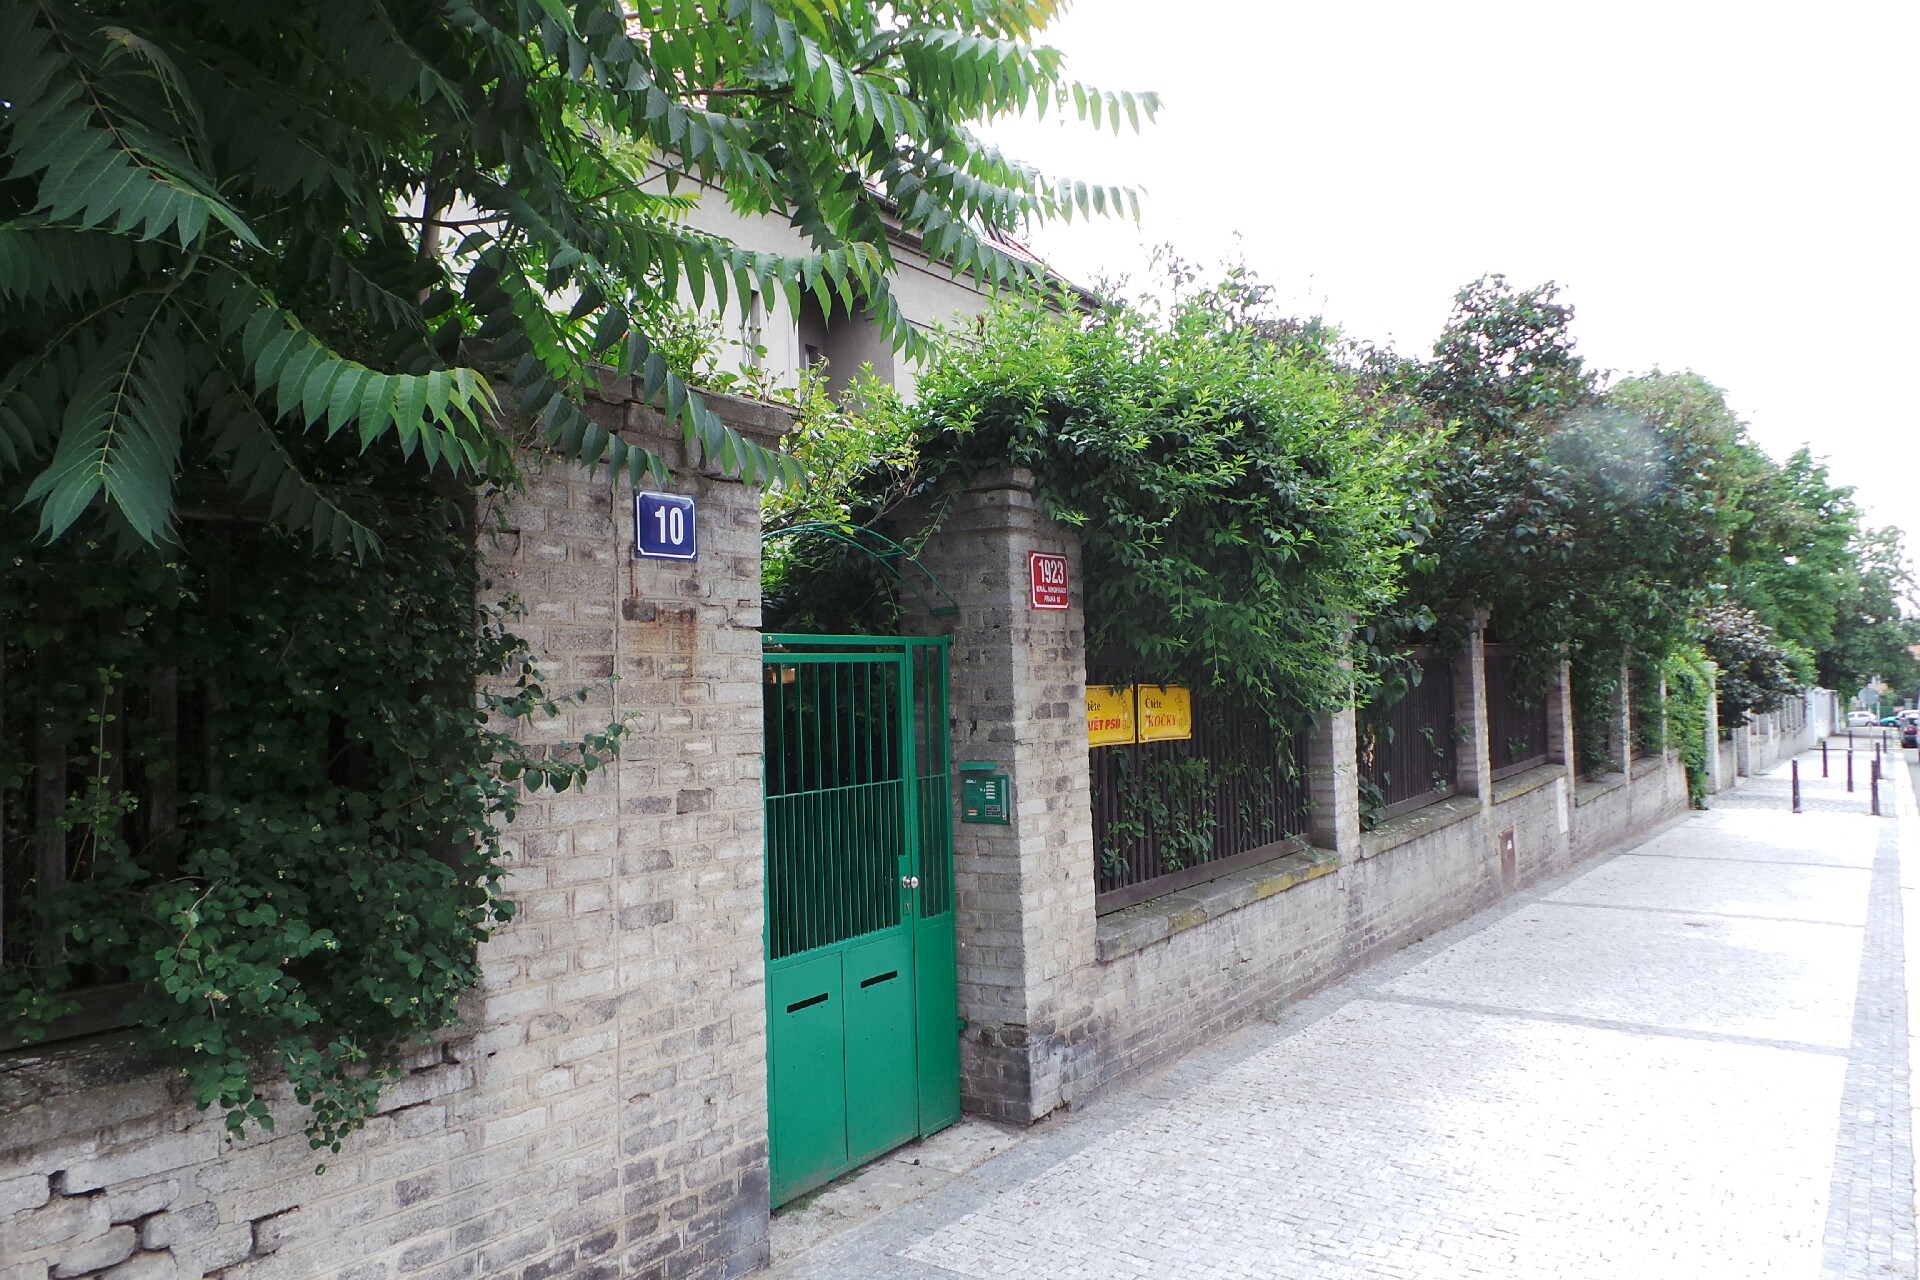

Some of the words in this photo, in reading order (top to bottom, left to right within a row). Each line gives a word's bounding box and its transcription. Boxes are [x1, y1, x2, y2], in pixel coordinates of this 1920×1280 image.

[654, 505, 684, 546] 10
[1038, 559, 1064, 584] 1923
[1087, 700, 1101, 712] těte
[1088, 716, 1104, 732] VĚT
[1148, 713, 1177, 728] KOČKY
